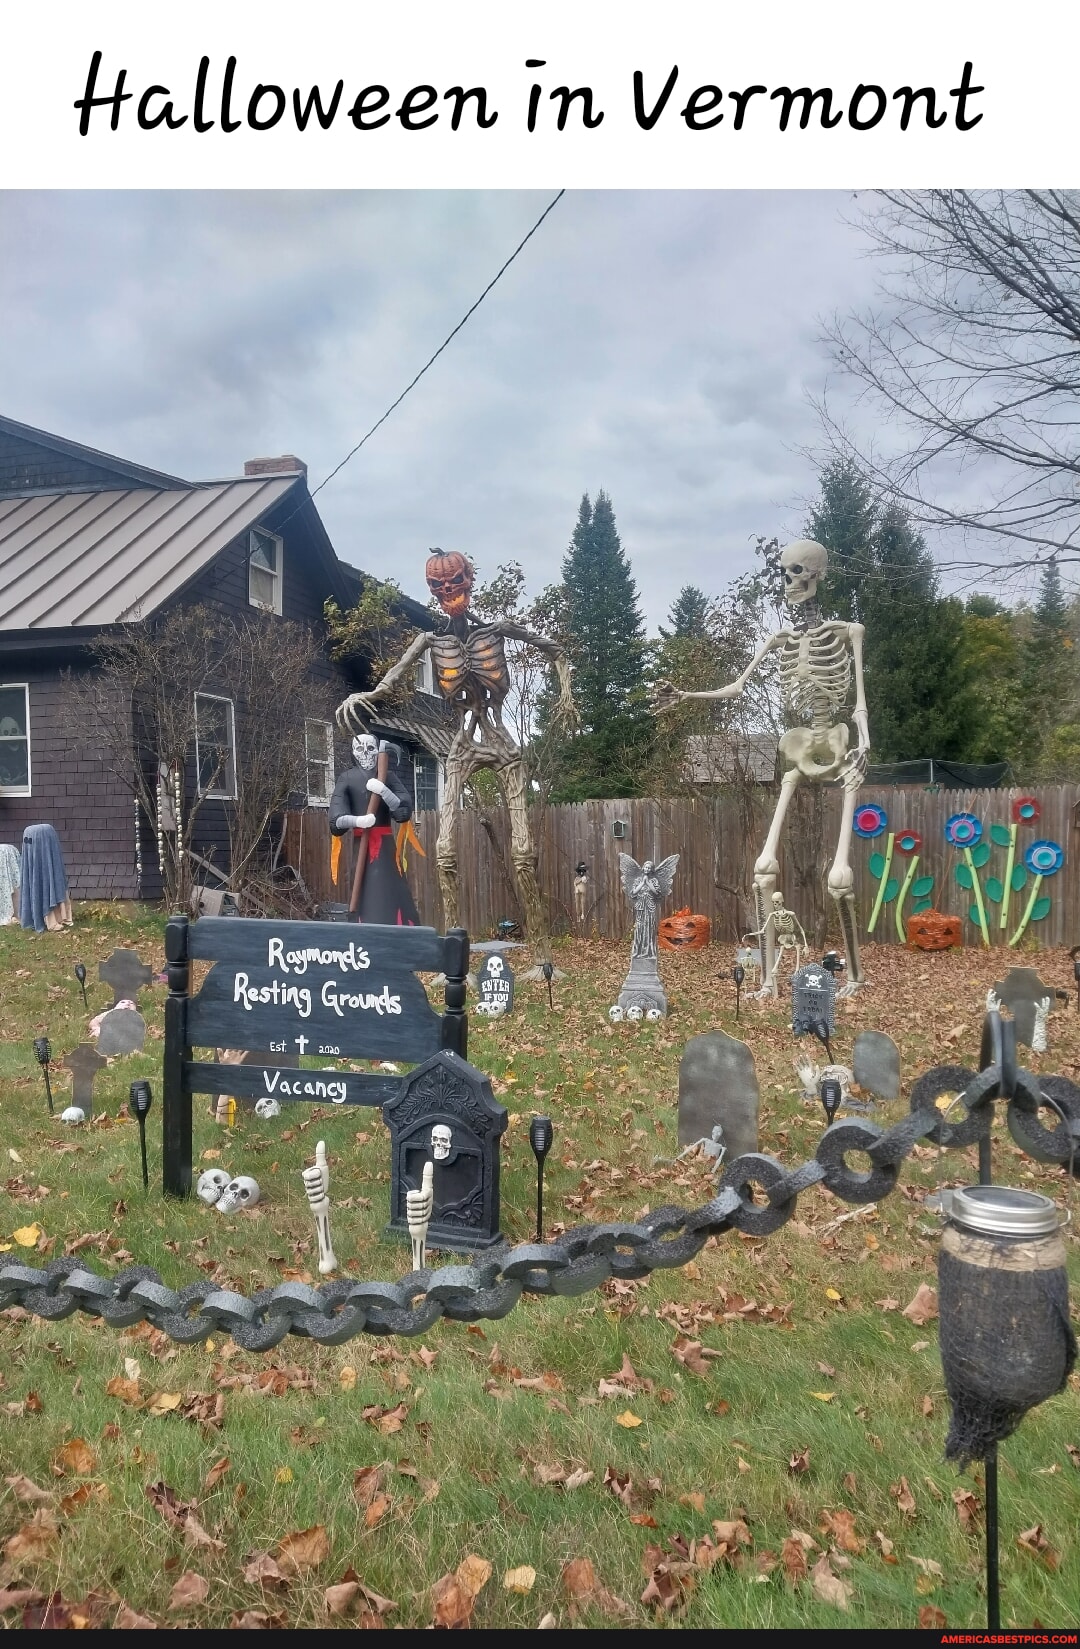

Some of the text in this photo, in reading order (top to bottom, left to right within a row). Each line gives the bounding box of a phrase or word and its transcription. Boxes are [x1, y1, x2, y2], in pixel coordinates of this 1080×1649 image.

[268, 937, 371, 975] Raymond's
[233, 972, 402, 1018] Resting Grounds
[481, 979, 510, 993] ENTER
[484, 993, 509, 1002] IF YOU
[318, 1045, 340, 1055] 2020
[263, 1070, 347, 1104] Vacancy
